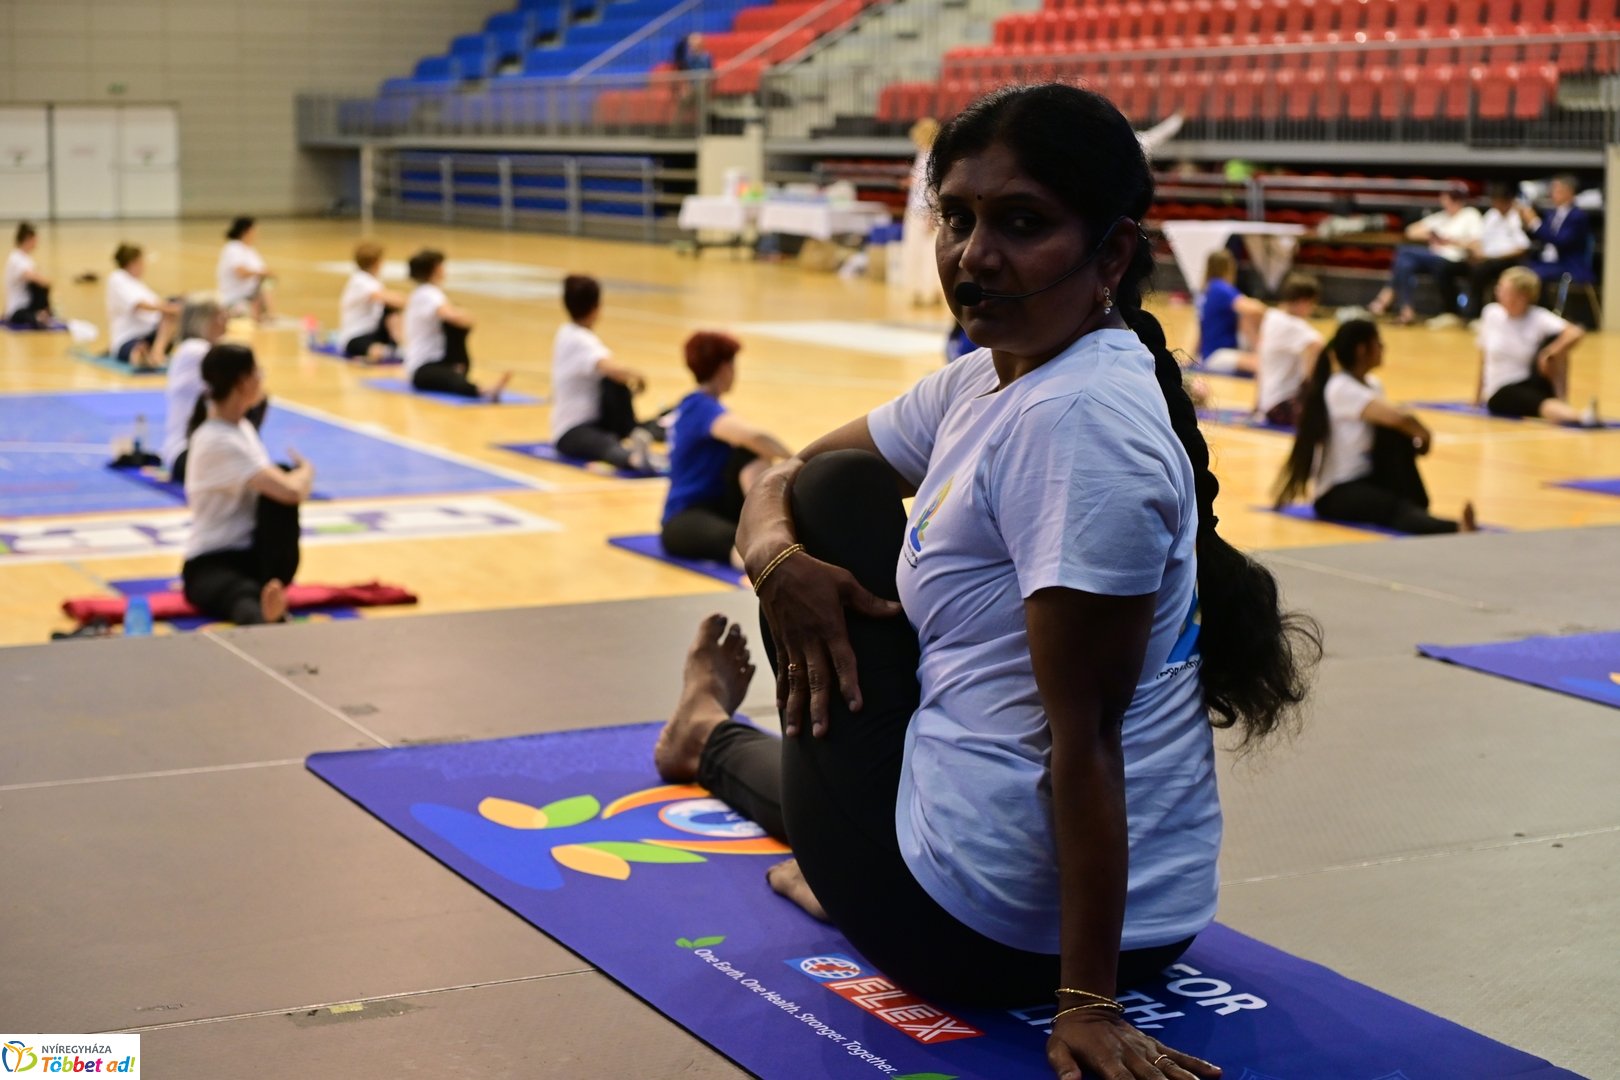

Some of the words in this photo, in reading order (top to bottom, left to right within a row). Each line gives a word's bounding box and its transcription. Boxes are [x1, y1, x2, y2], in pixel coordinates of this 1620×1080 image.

[694, 949, 719, 963] One
[740, 979, 766, 994] One
[760, 992, 800, 1014] Health.
[794, 1013, 847, 1042] Stronger.
[842, 1041, 897, 1073] Together.
[829, 977, 976, 1041] FLEX
